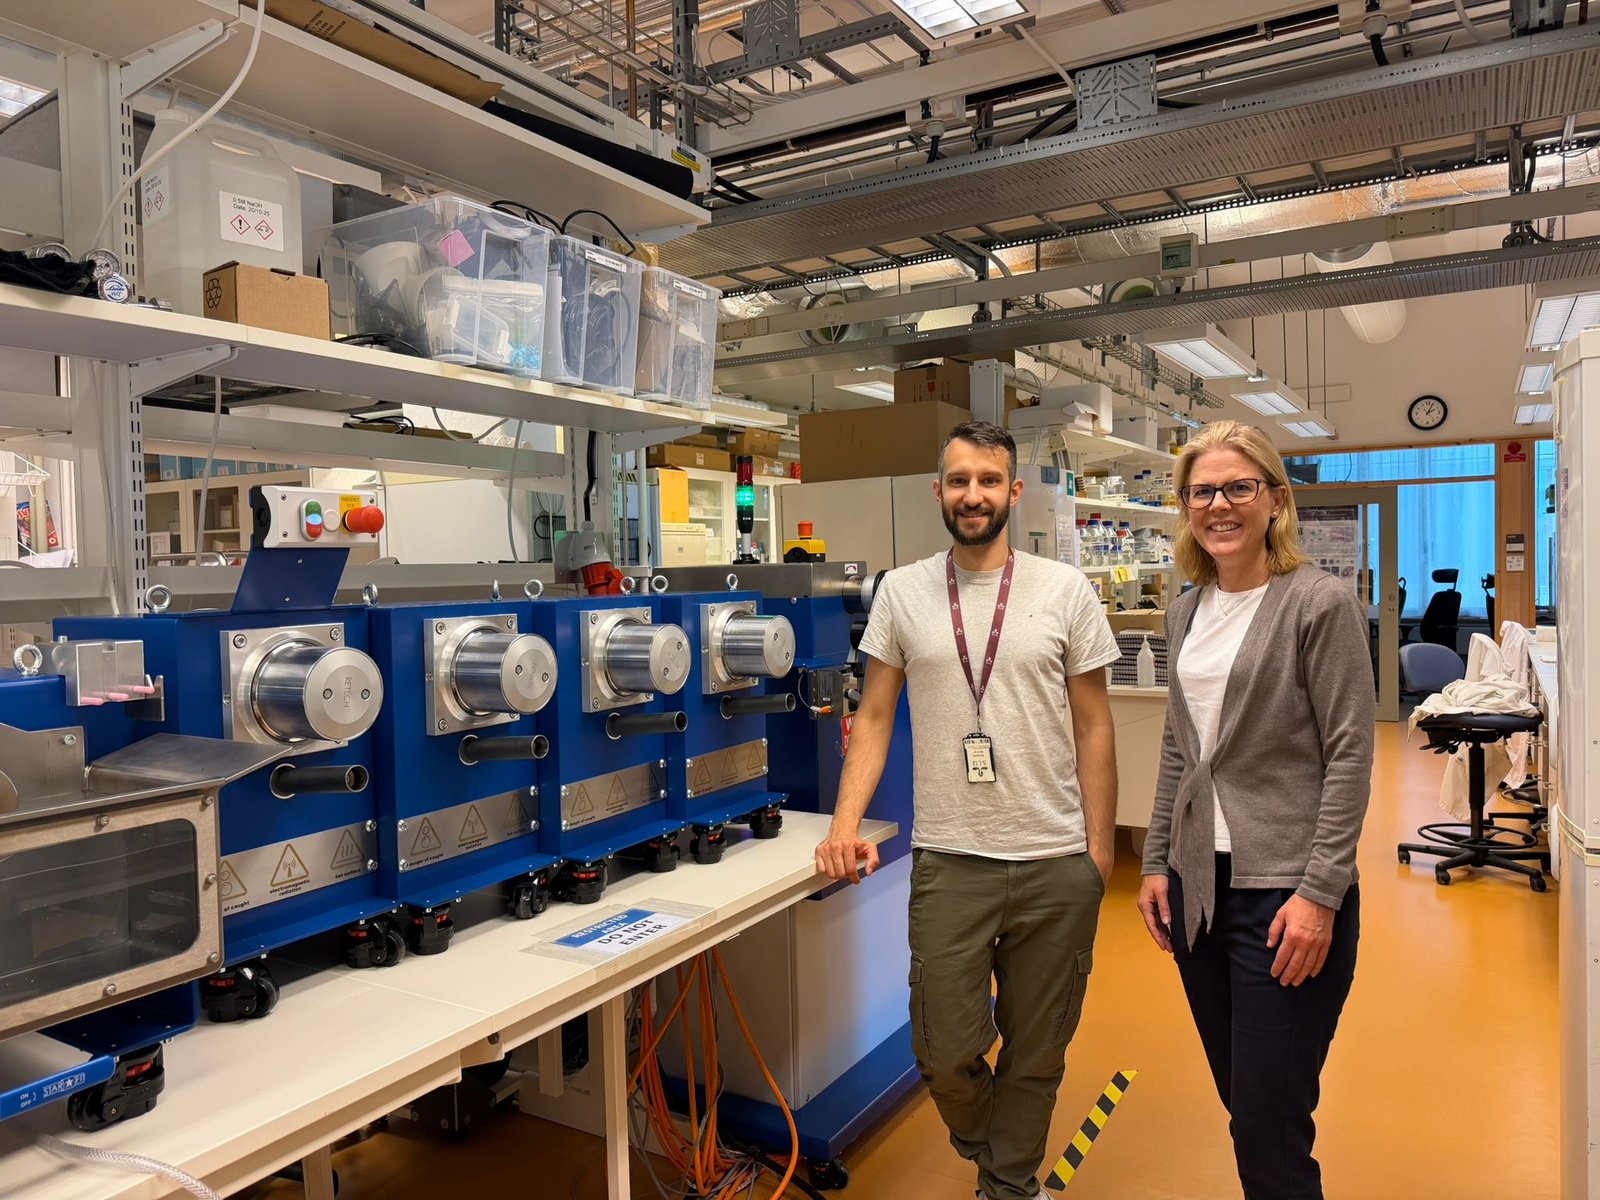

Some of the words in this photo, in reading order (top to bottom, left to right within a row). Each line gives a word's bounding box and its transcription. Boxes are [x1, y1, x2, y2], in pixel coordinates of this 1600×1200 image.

[246, 200, 262, 208] NaOH
[248, 206, 270, 216] 20/10-25
[270, 879, 310, 894] electromagnetic
[279, 886, 302, 896] radiation
[231, 900, 250, 910] caught
[572, 914, 628, 938] RESTRICTED
[598, 933, 624, 944] DO
[623, 920, 654, 933] NOT
[602, 922, 628, 934] AREA
[619, 924, 668, 945] ENTER
[43, 1082, 63, 1096] STAR
